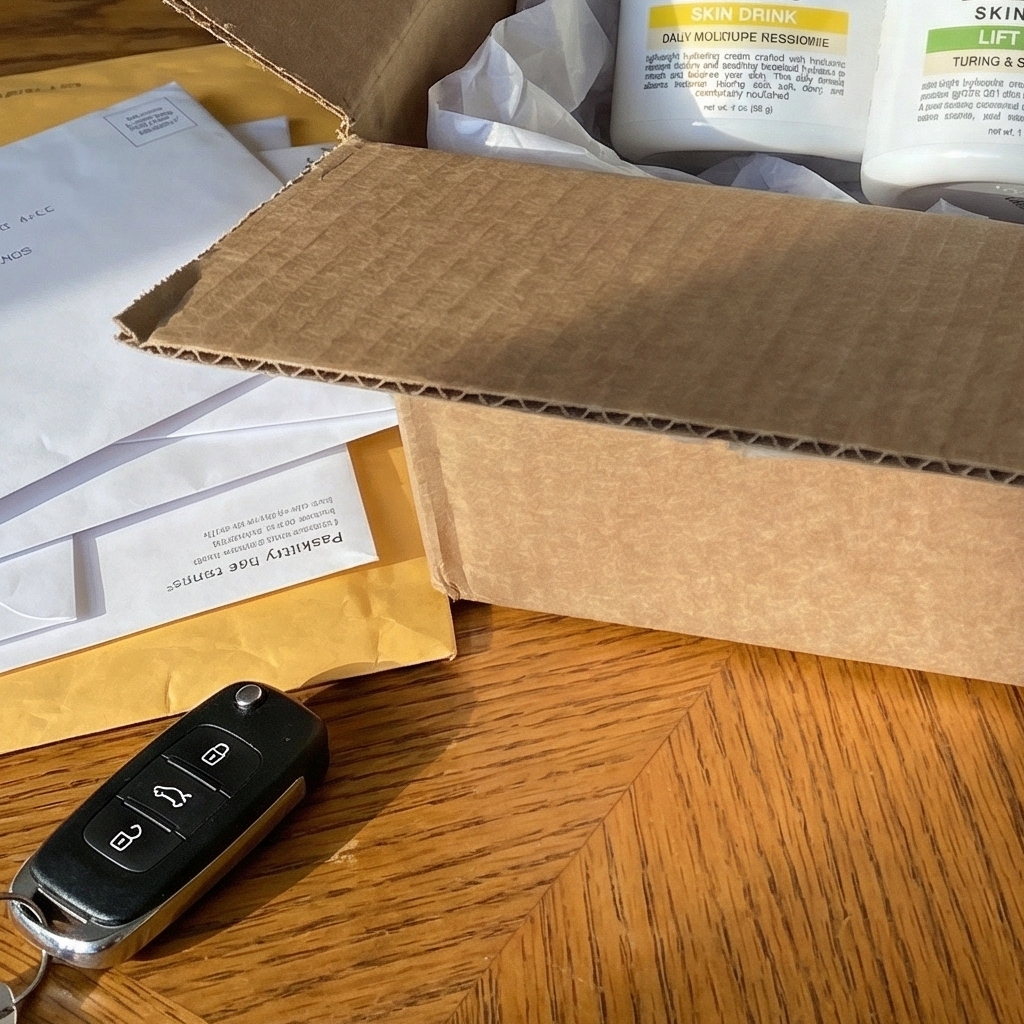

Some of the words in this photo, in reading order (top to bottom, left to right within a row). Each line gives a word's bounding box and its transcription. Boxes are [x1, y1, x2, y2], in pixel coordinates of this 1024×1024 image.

[690, 6, 733, 22] SKIN
[738, 9, 798, 25] DRINK
[978, 29, 1020, 46] LIFT
[952, 56, 1001, 67] TURING
[1004, 56, 1013, 67] &
